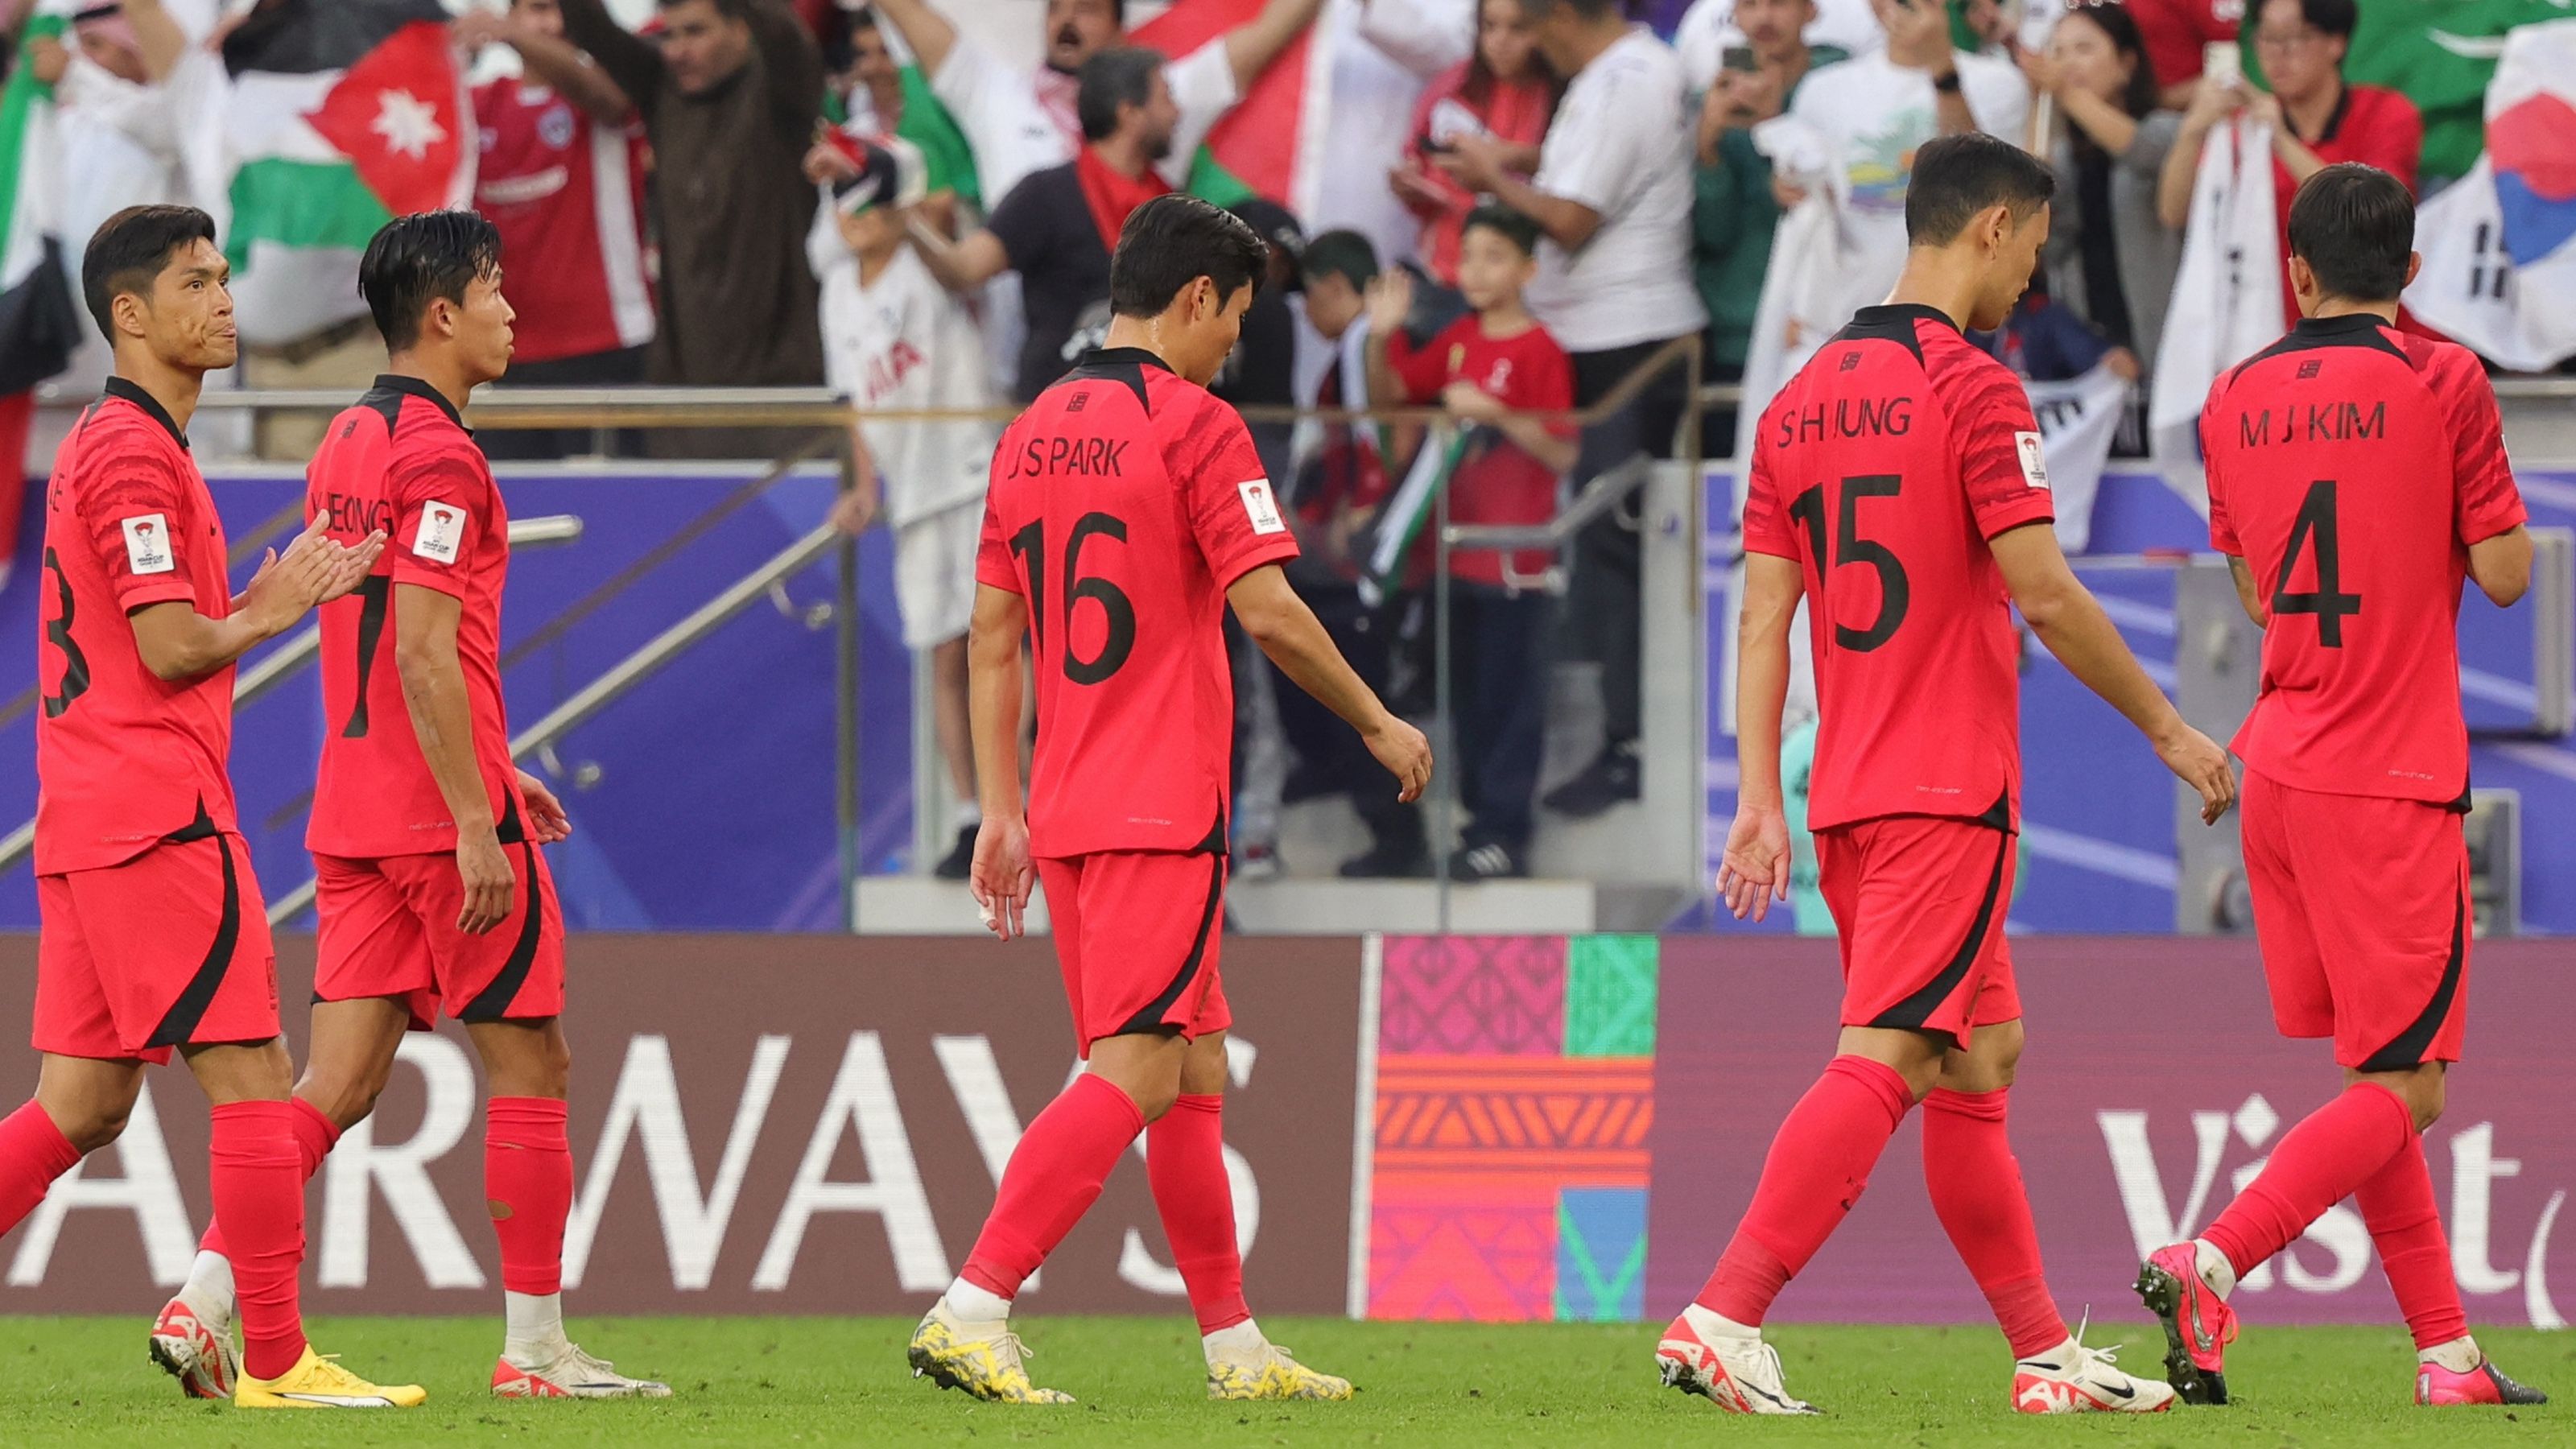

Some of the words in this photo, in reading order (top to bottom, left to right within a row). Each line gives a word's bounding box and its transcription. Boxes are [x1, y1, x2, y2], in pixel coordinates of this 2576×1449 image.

[2241, 410, 2270, 449] M
[2281, 405, 2295, 444] J
[2308, 402, 2385, 441] KIM
[44, 546, 90, 719] 3
[1009, 511, 1137, 685] 16
[1789, 474, 1910, 654] 15
[2272, 480, 2362, 648] 4
[6, 1030, 1261, 1295] ARWAYS
[2097, 1092, 2521, 1294] Vist
